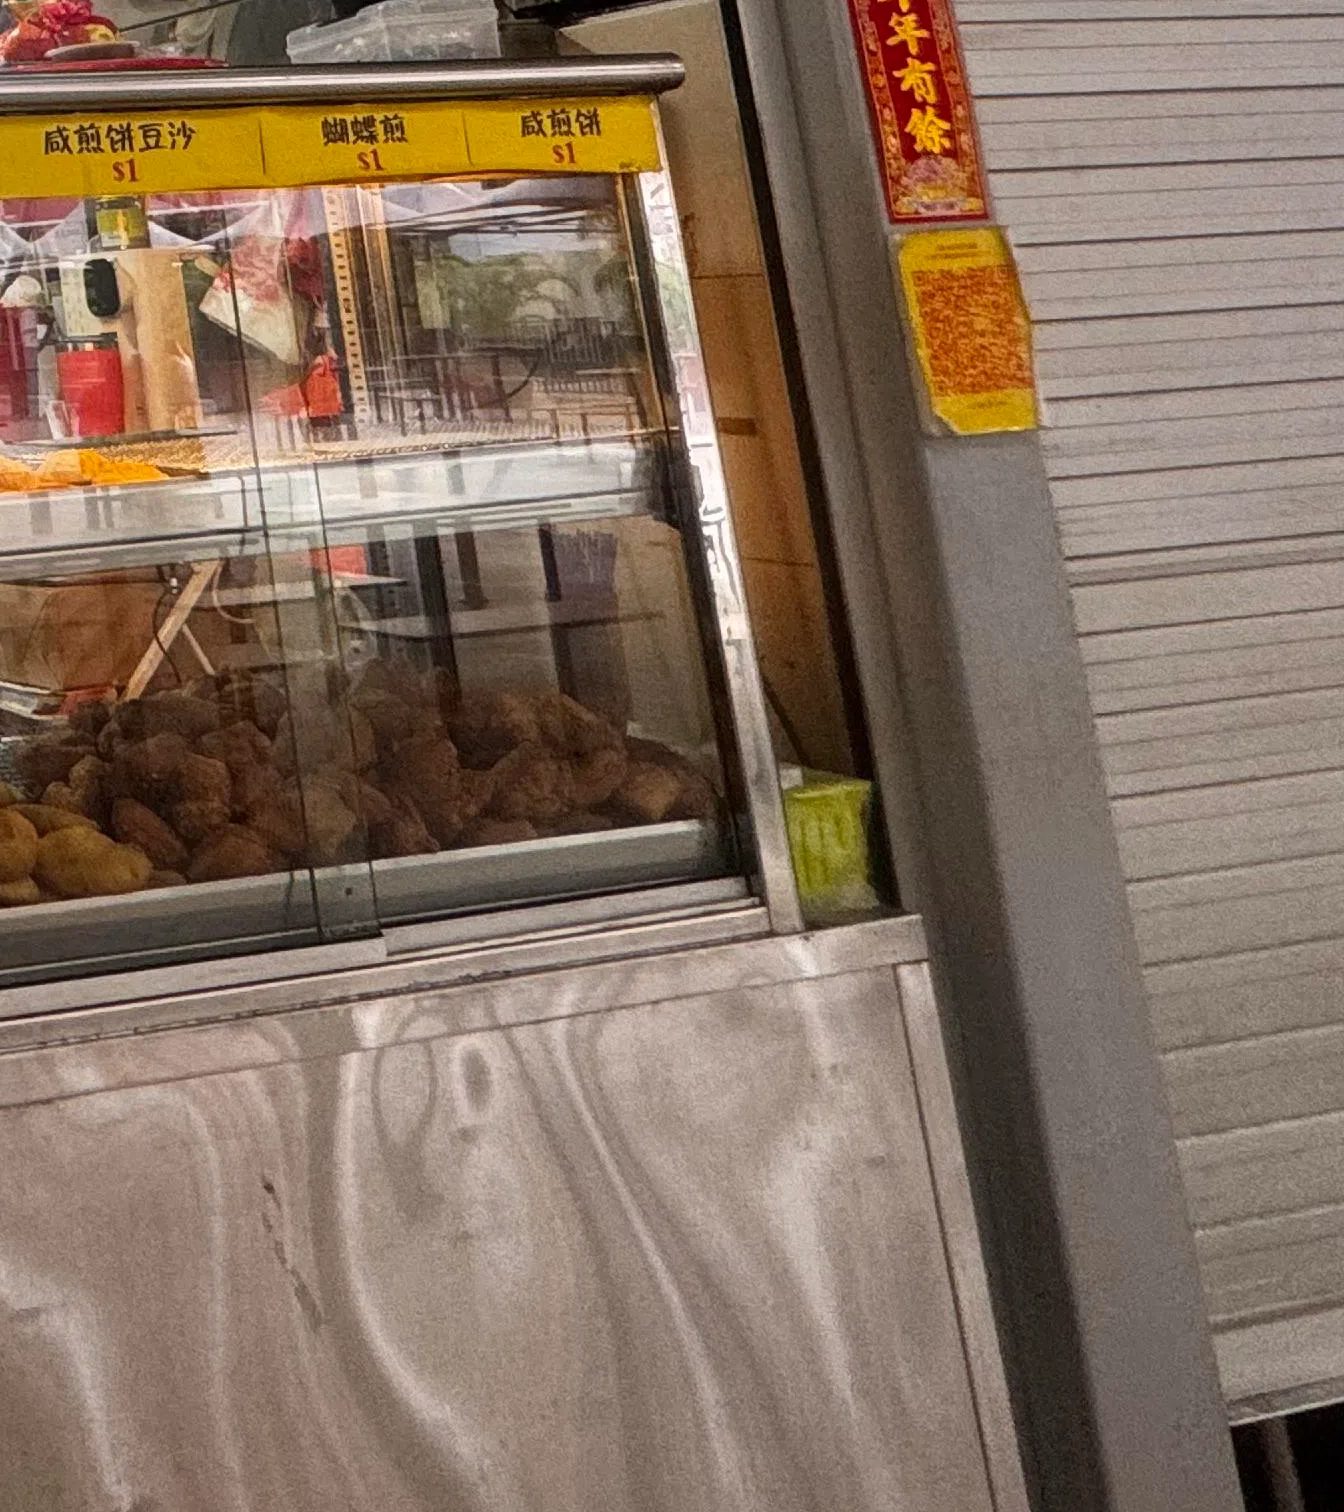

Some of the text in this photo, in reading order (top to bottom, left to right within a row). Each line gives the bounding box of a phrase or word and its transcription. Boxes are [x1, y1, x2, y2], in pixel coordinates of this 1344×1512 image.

[321, 113, 408, 146] 蝴蝶煎
[520, 107, 602, 138] 咸煎饼
[44, 120, 197, 155] 咸煎饼豆沙
[356, 148, 384, 171] $1
[551, 141, 577, 164] $1
[112, 159, 140, 182] $1
